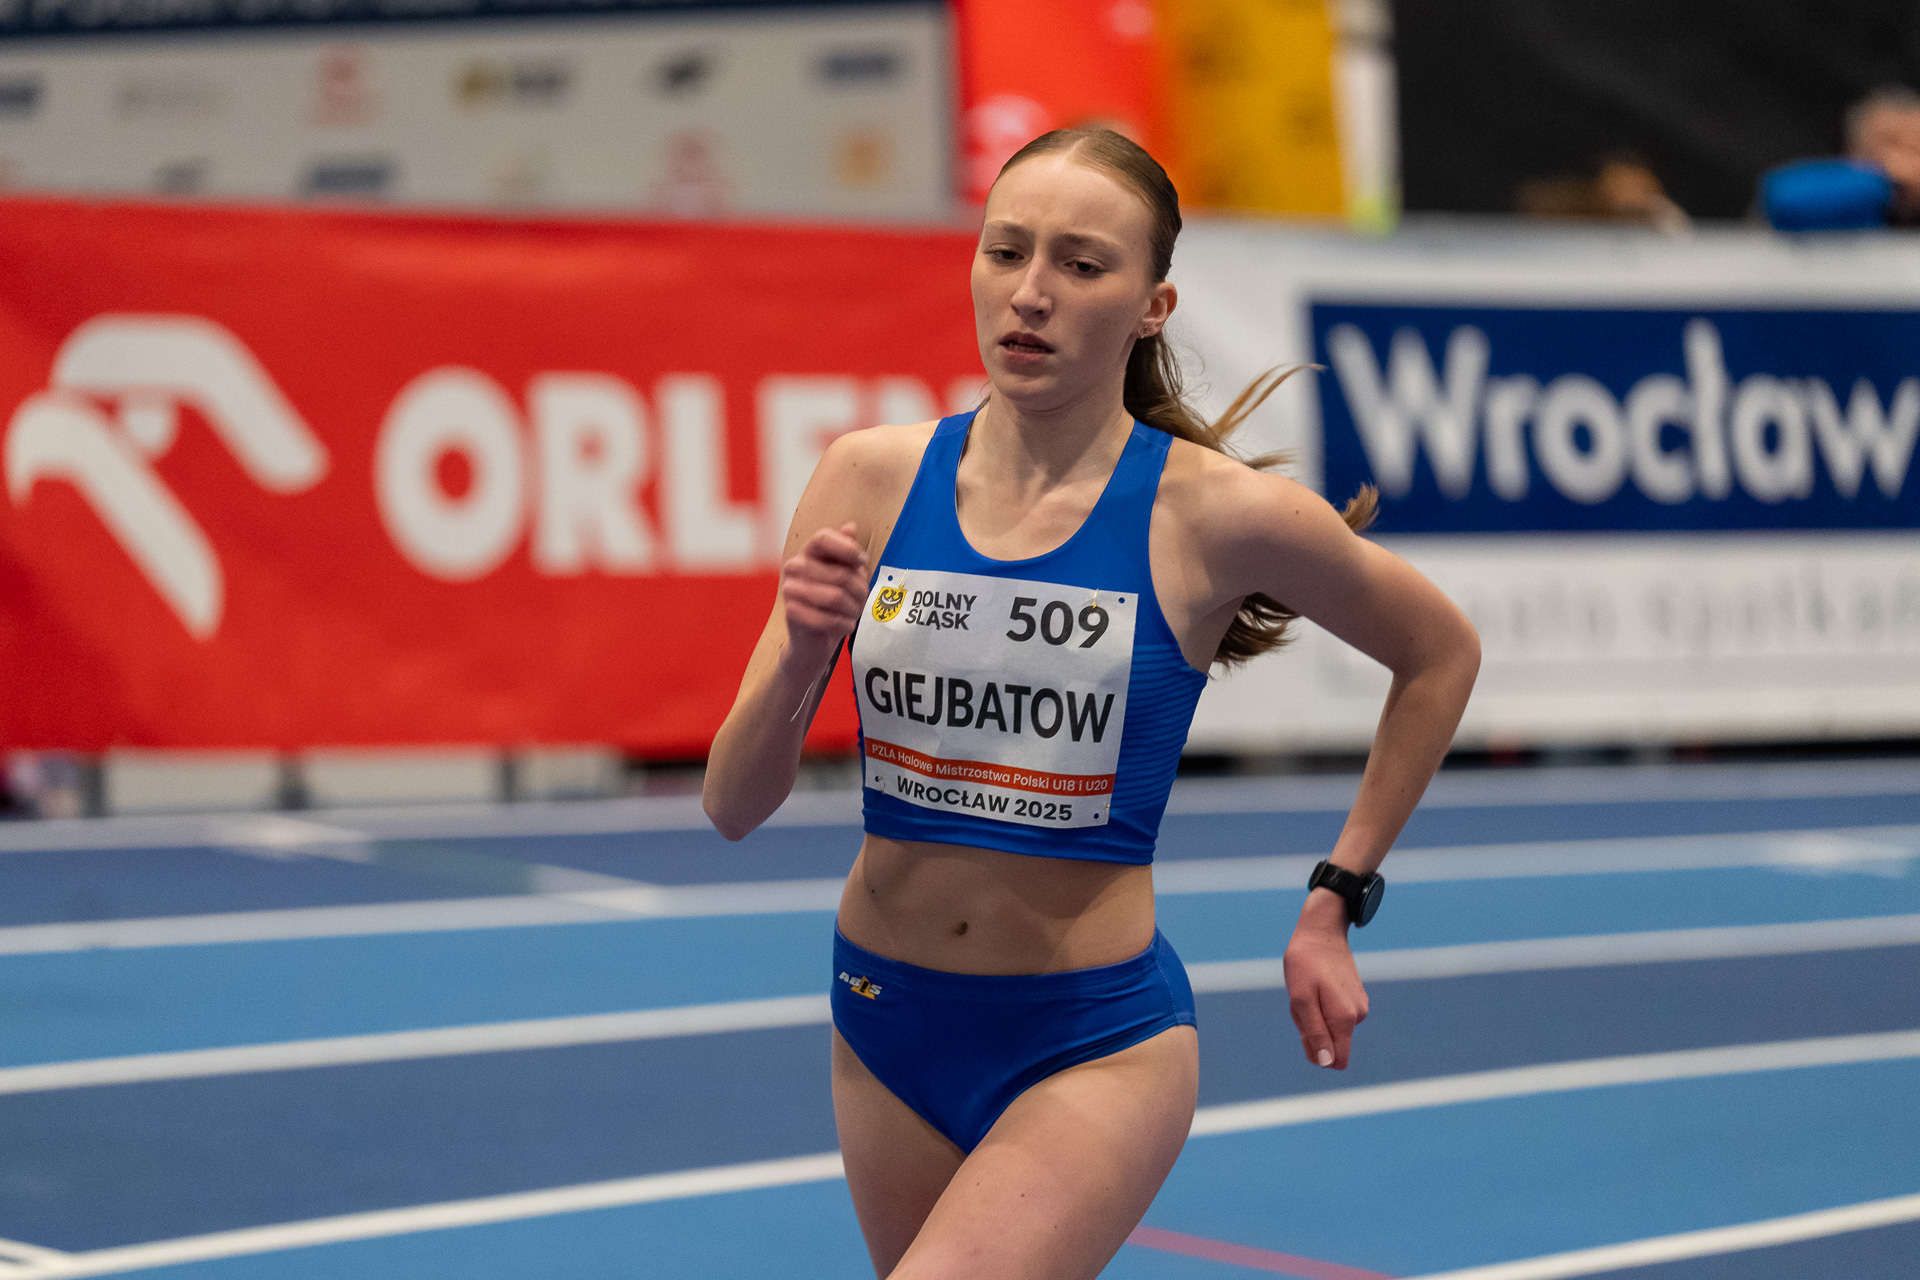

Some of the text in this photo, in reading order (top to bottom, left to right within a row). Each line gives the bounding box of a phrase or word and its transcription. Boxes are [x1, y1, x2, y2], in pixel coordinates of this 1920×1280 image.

[374, 364, 988, 581] ORLE
[905, 604, 970, 631] ŚLĄSK
[911, 590, 977, 611] DOLNY
[1006, 596, 1110, 649] 509
[864, 667, 1116, 743] GIEJBATOW
[871, 744, 1108, 792] PZLA Halowe Mistrzostwa Polski U18 i U20
[897, 775, 1073, 821] WROCŁAW 2025
